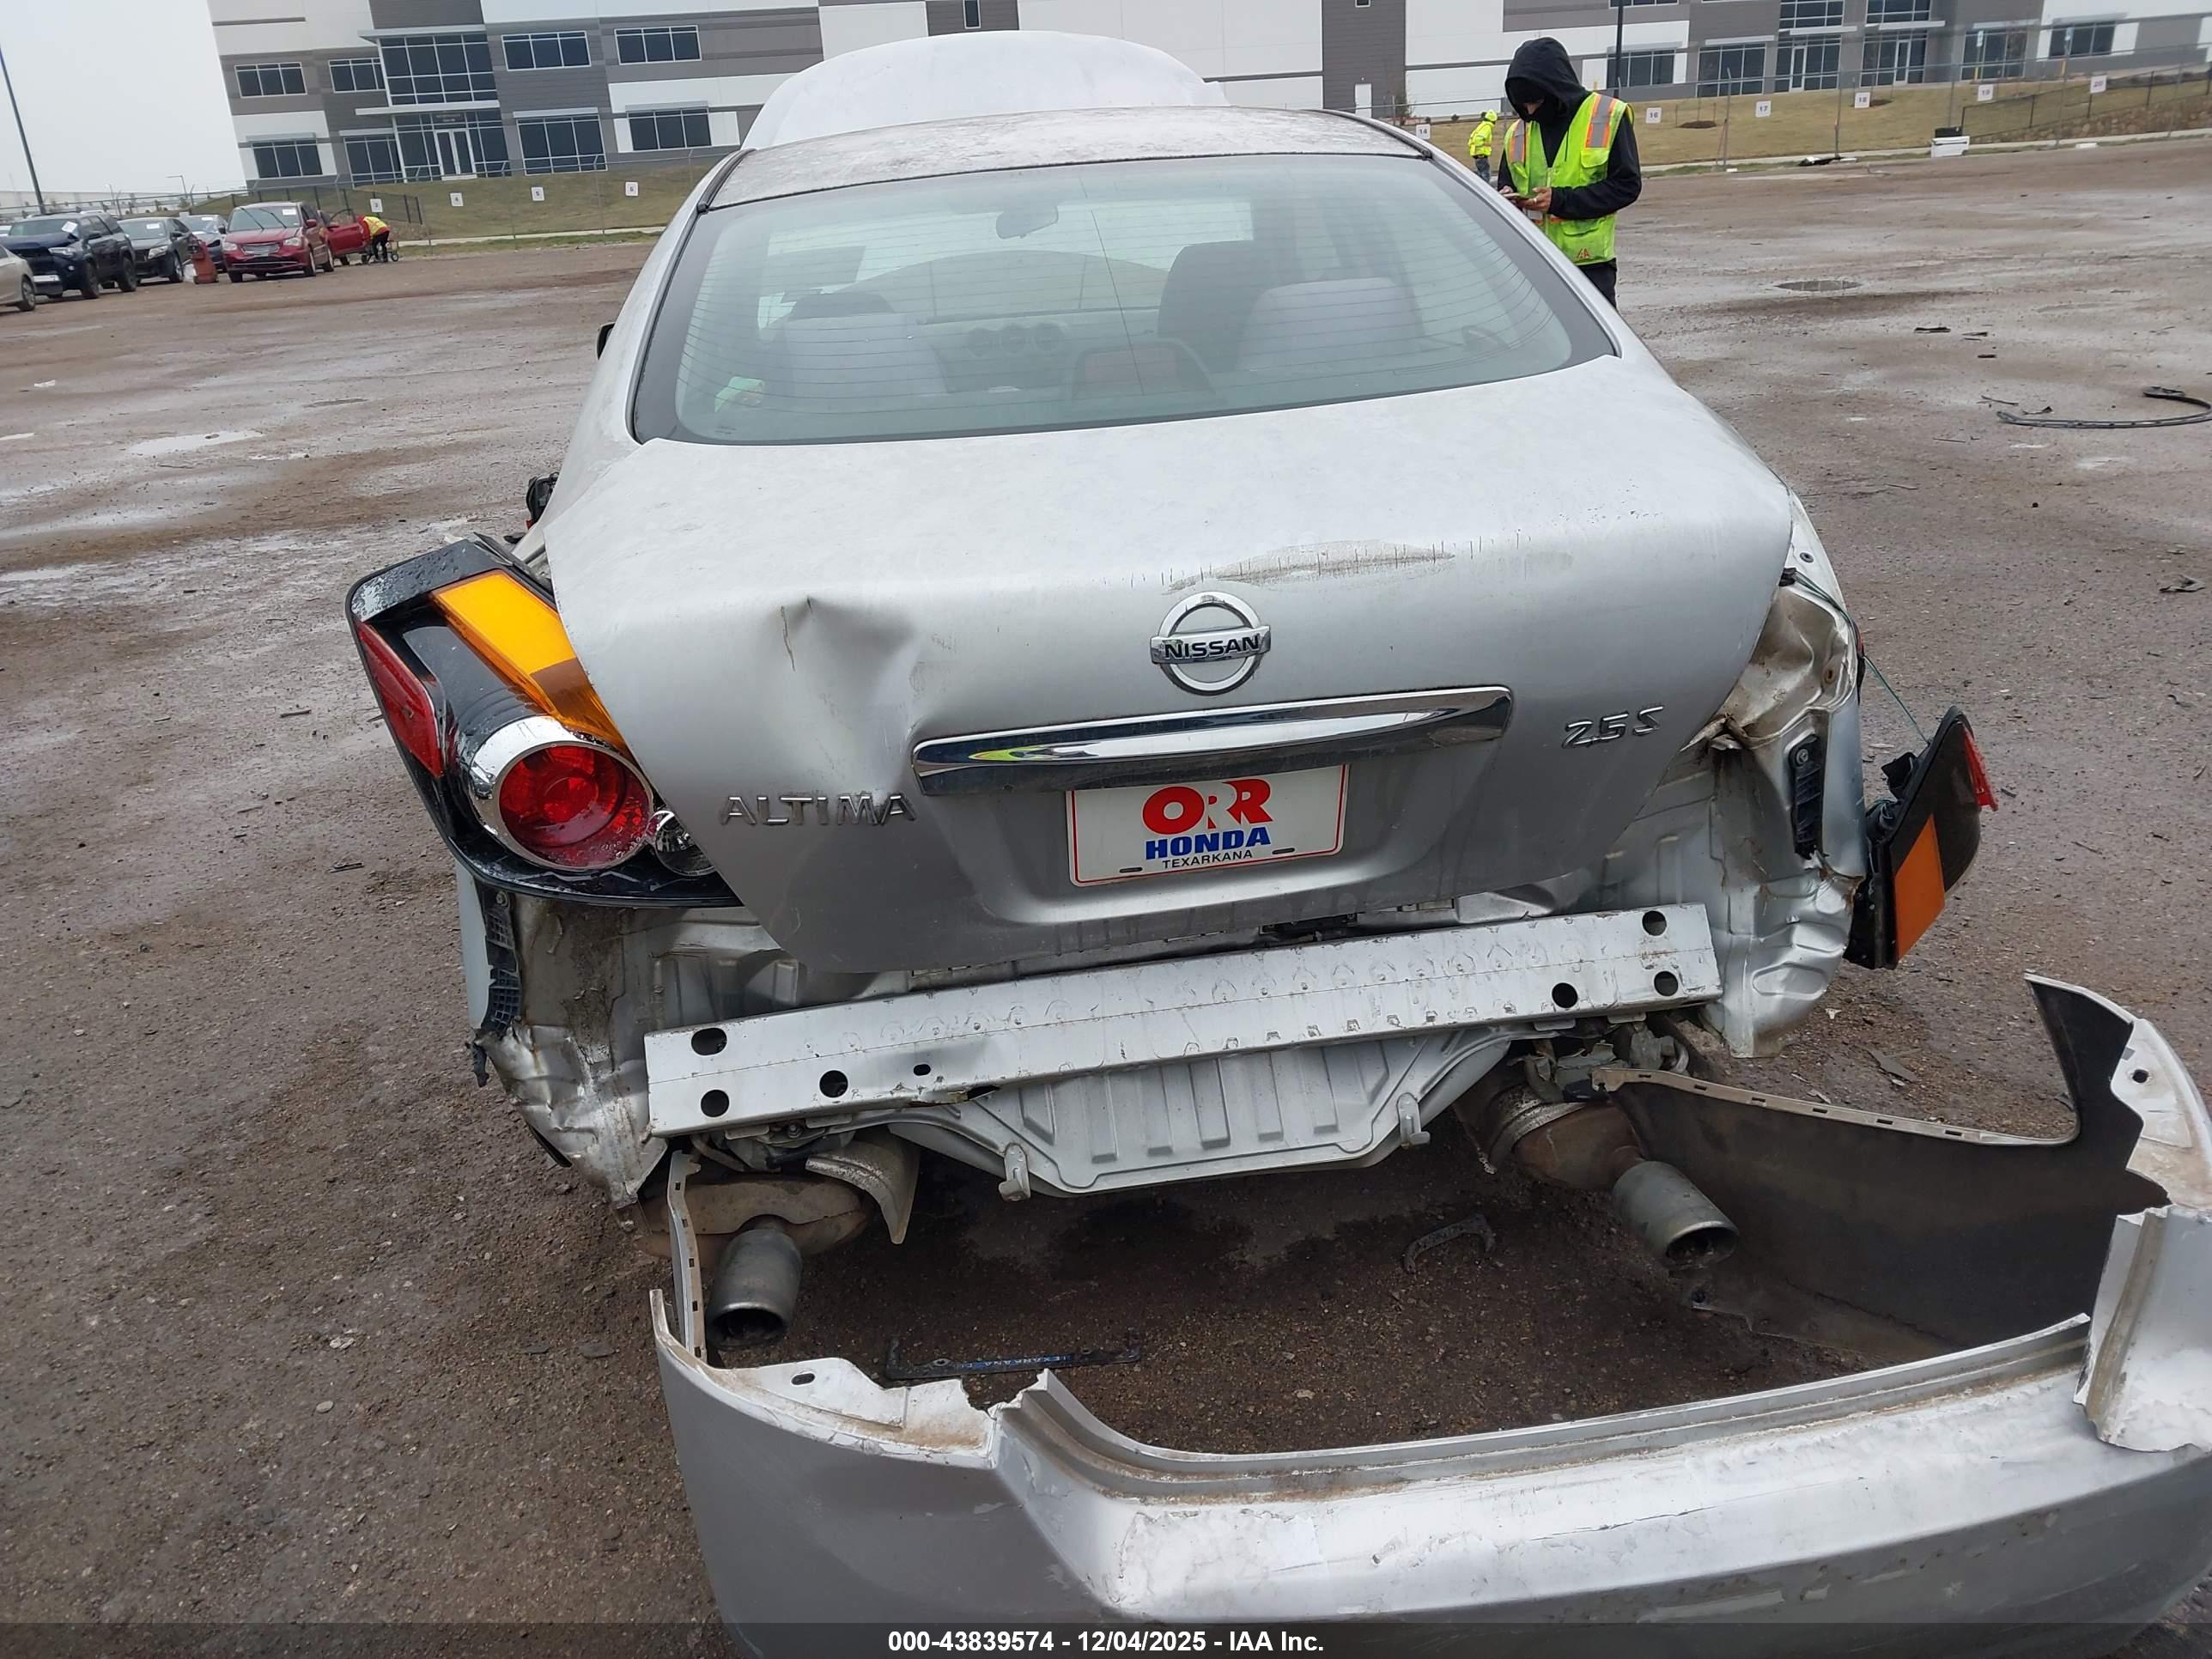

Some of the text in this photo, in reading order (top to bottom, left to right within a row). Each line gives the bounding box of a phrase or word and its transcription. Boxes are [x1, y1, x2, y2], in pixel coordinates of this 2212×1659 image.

[1164, 633, 1261, 659] NISSAN
[720, 795, 916, 825] ALTIMA
[1142, 778, 1273, 835] ORR
[1146, 826, 1271, 860] HONDA
[1163, 849, 1253, 869] TEXARKANA
